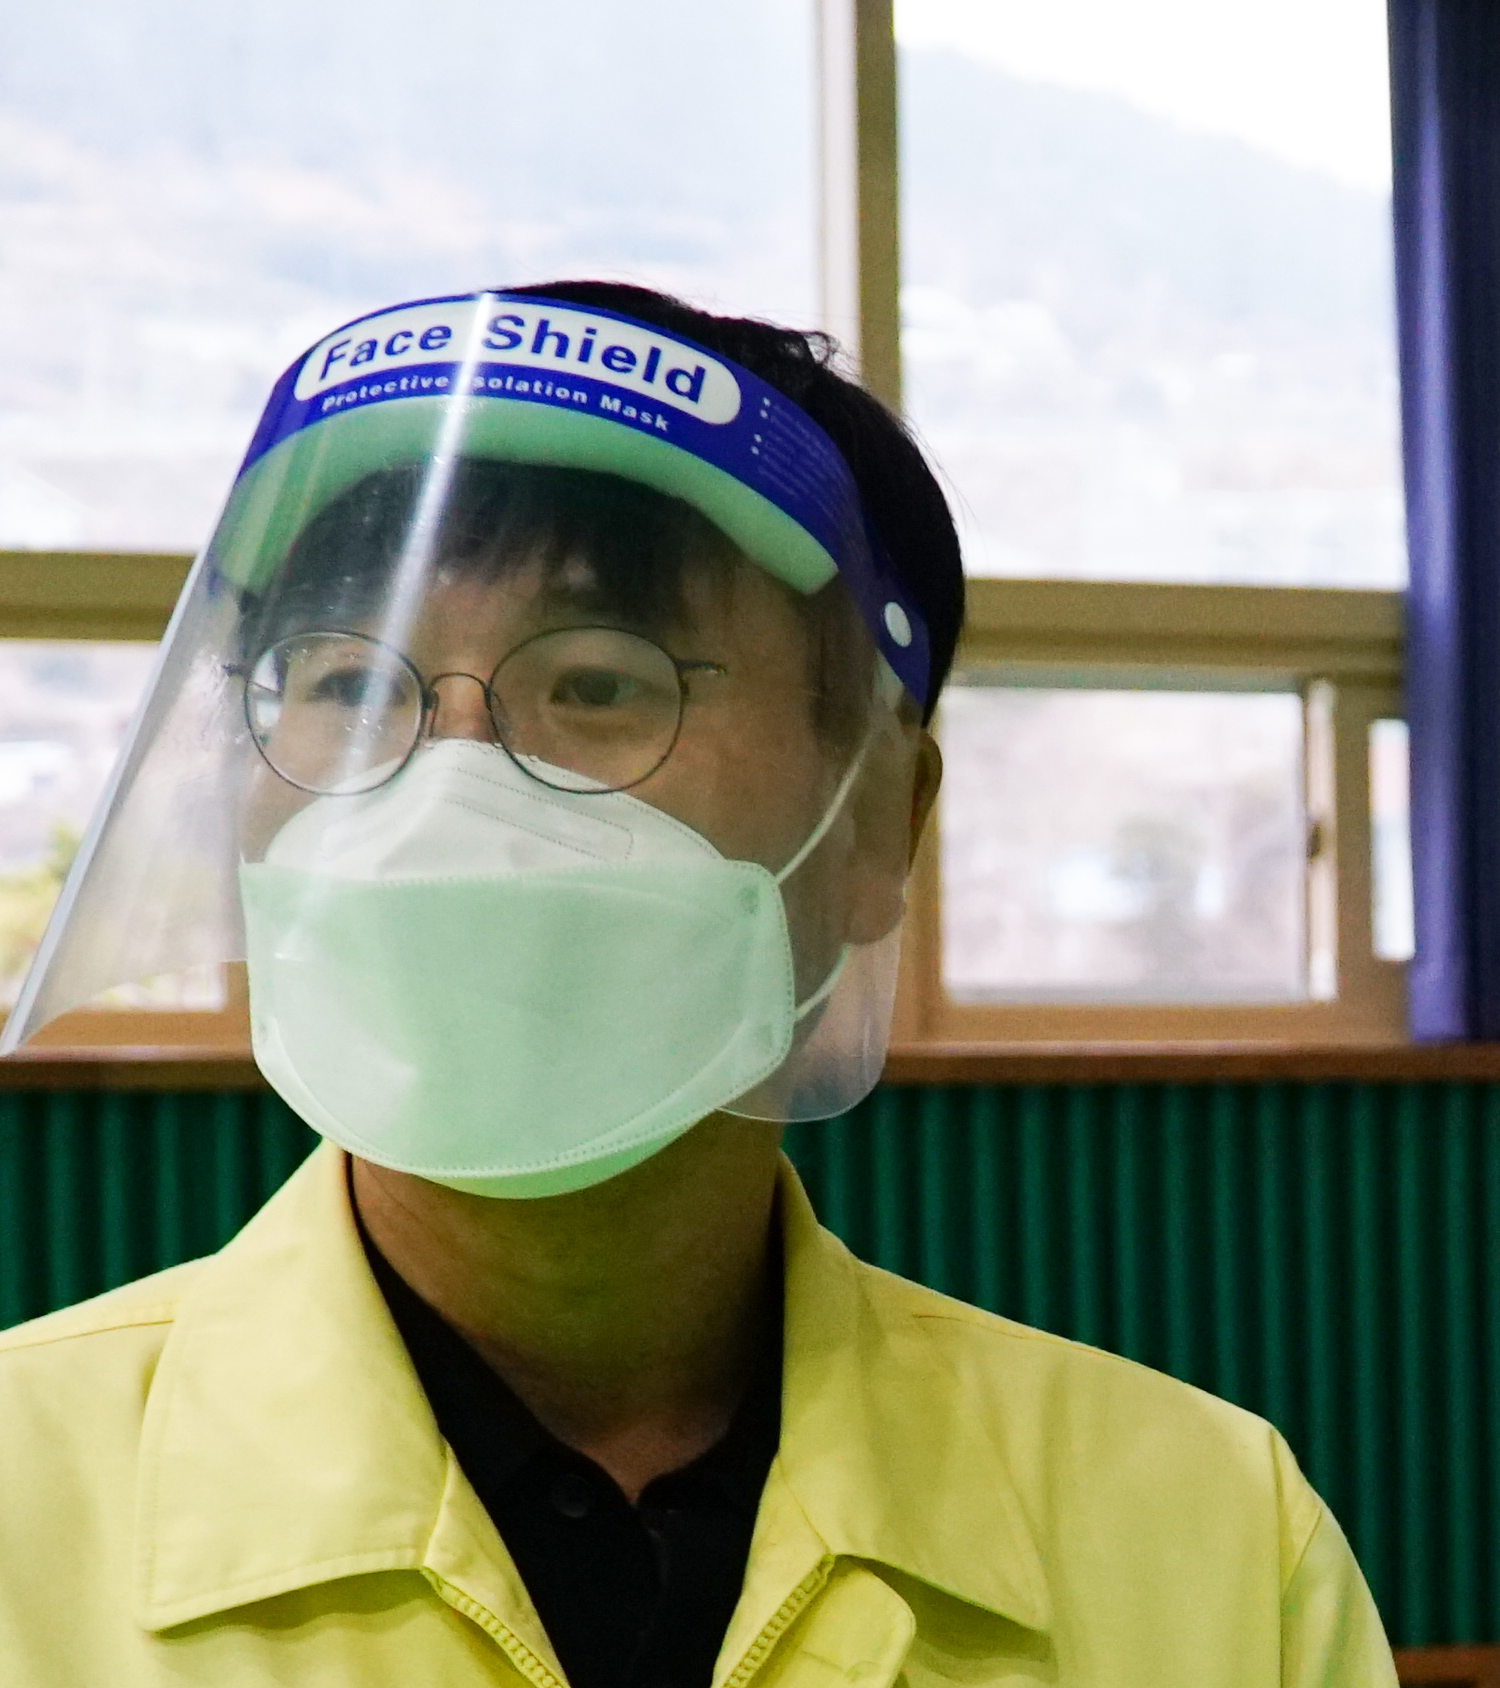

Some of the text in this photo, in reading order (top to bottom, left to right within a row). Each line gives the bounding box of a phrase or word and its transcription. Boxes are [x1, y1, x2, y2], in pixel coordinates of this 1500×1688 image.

[318, 313, 708, 404] Face Shield
[321, 375, 670, 431] Protective solation Mask
